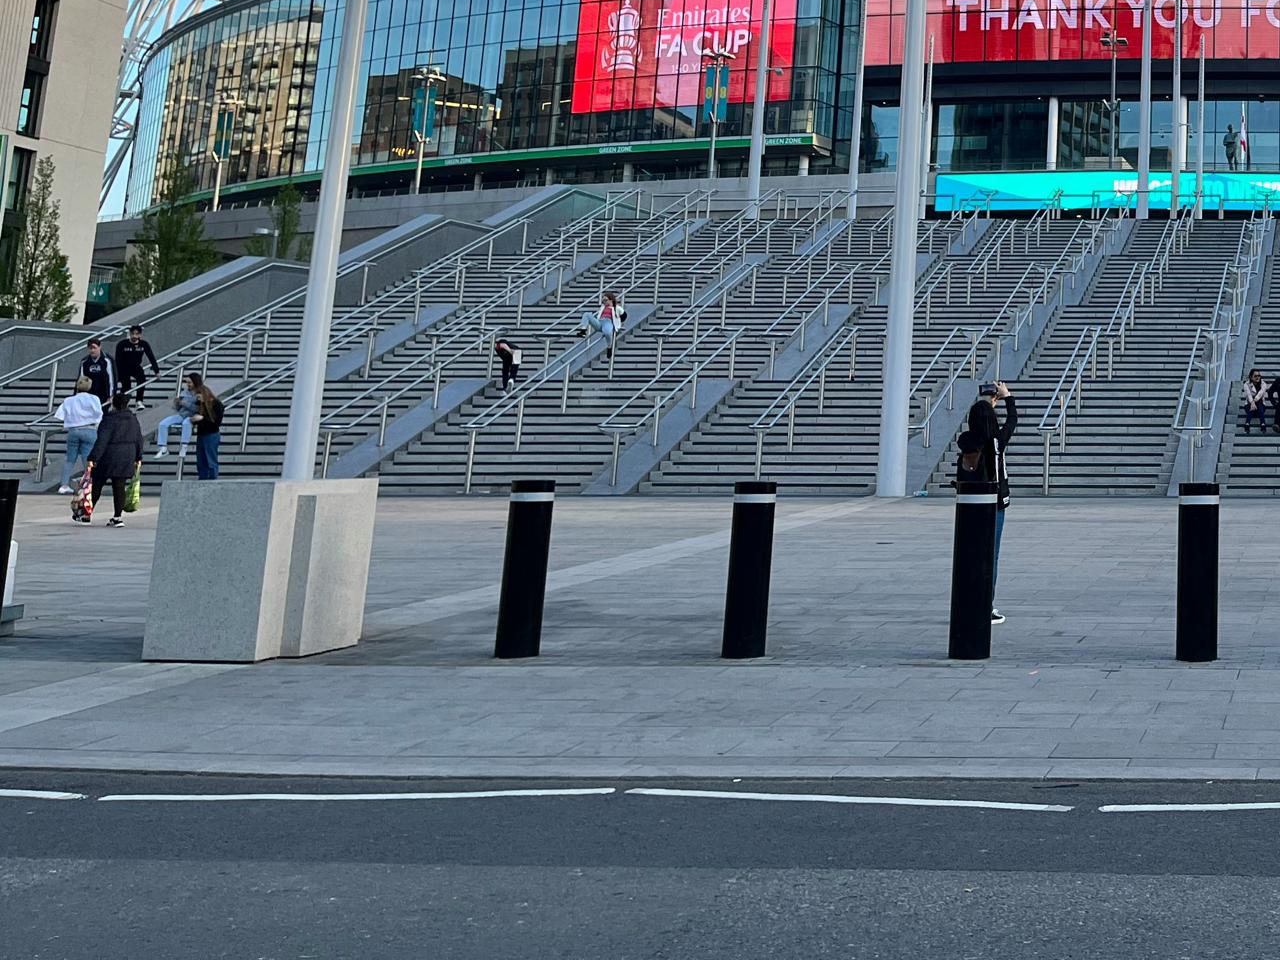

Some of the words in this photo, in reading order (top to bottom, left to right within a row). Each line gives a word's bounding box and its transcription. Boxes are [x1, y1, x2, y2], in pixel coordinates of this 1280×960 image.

[657, 4, 751, 30] Emirates
[655, 34, 688, 58] FA
[692, 29, 752, 56] CUP
